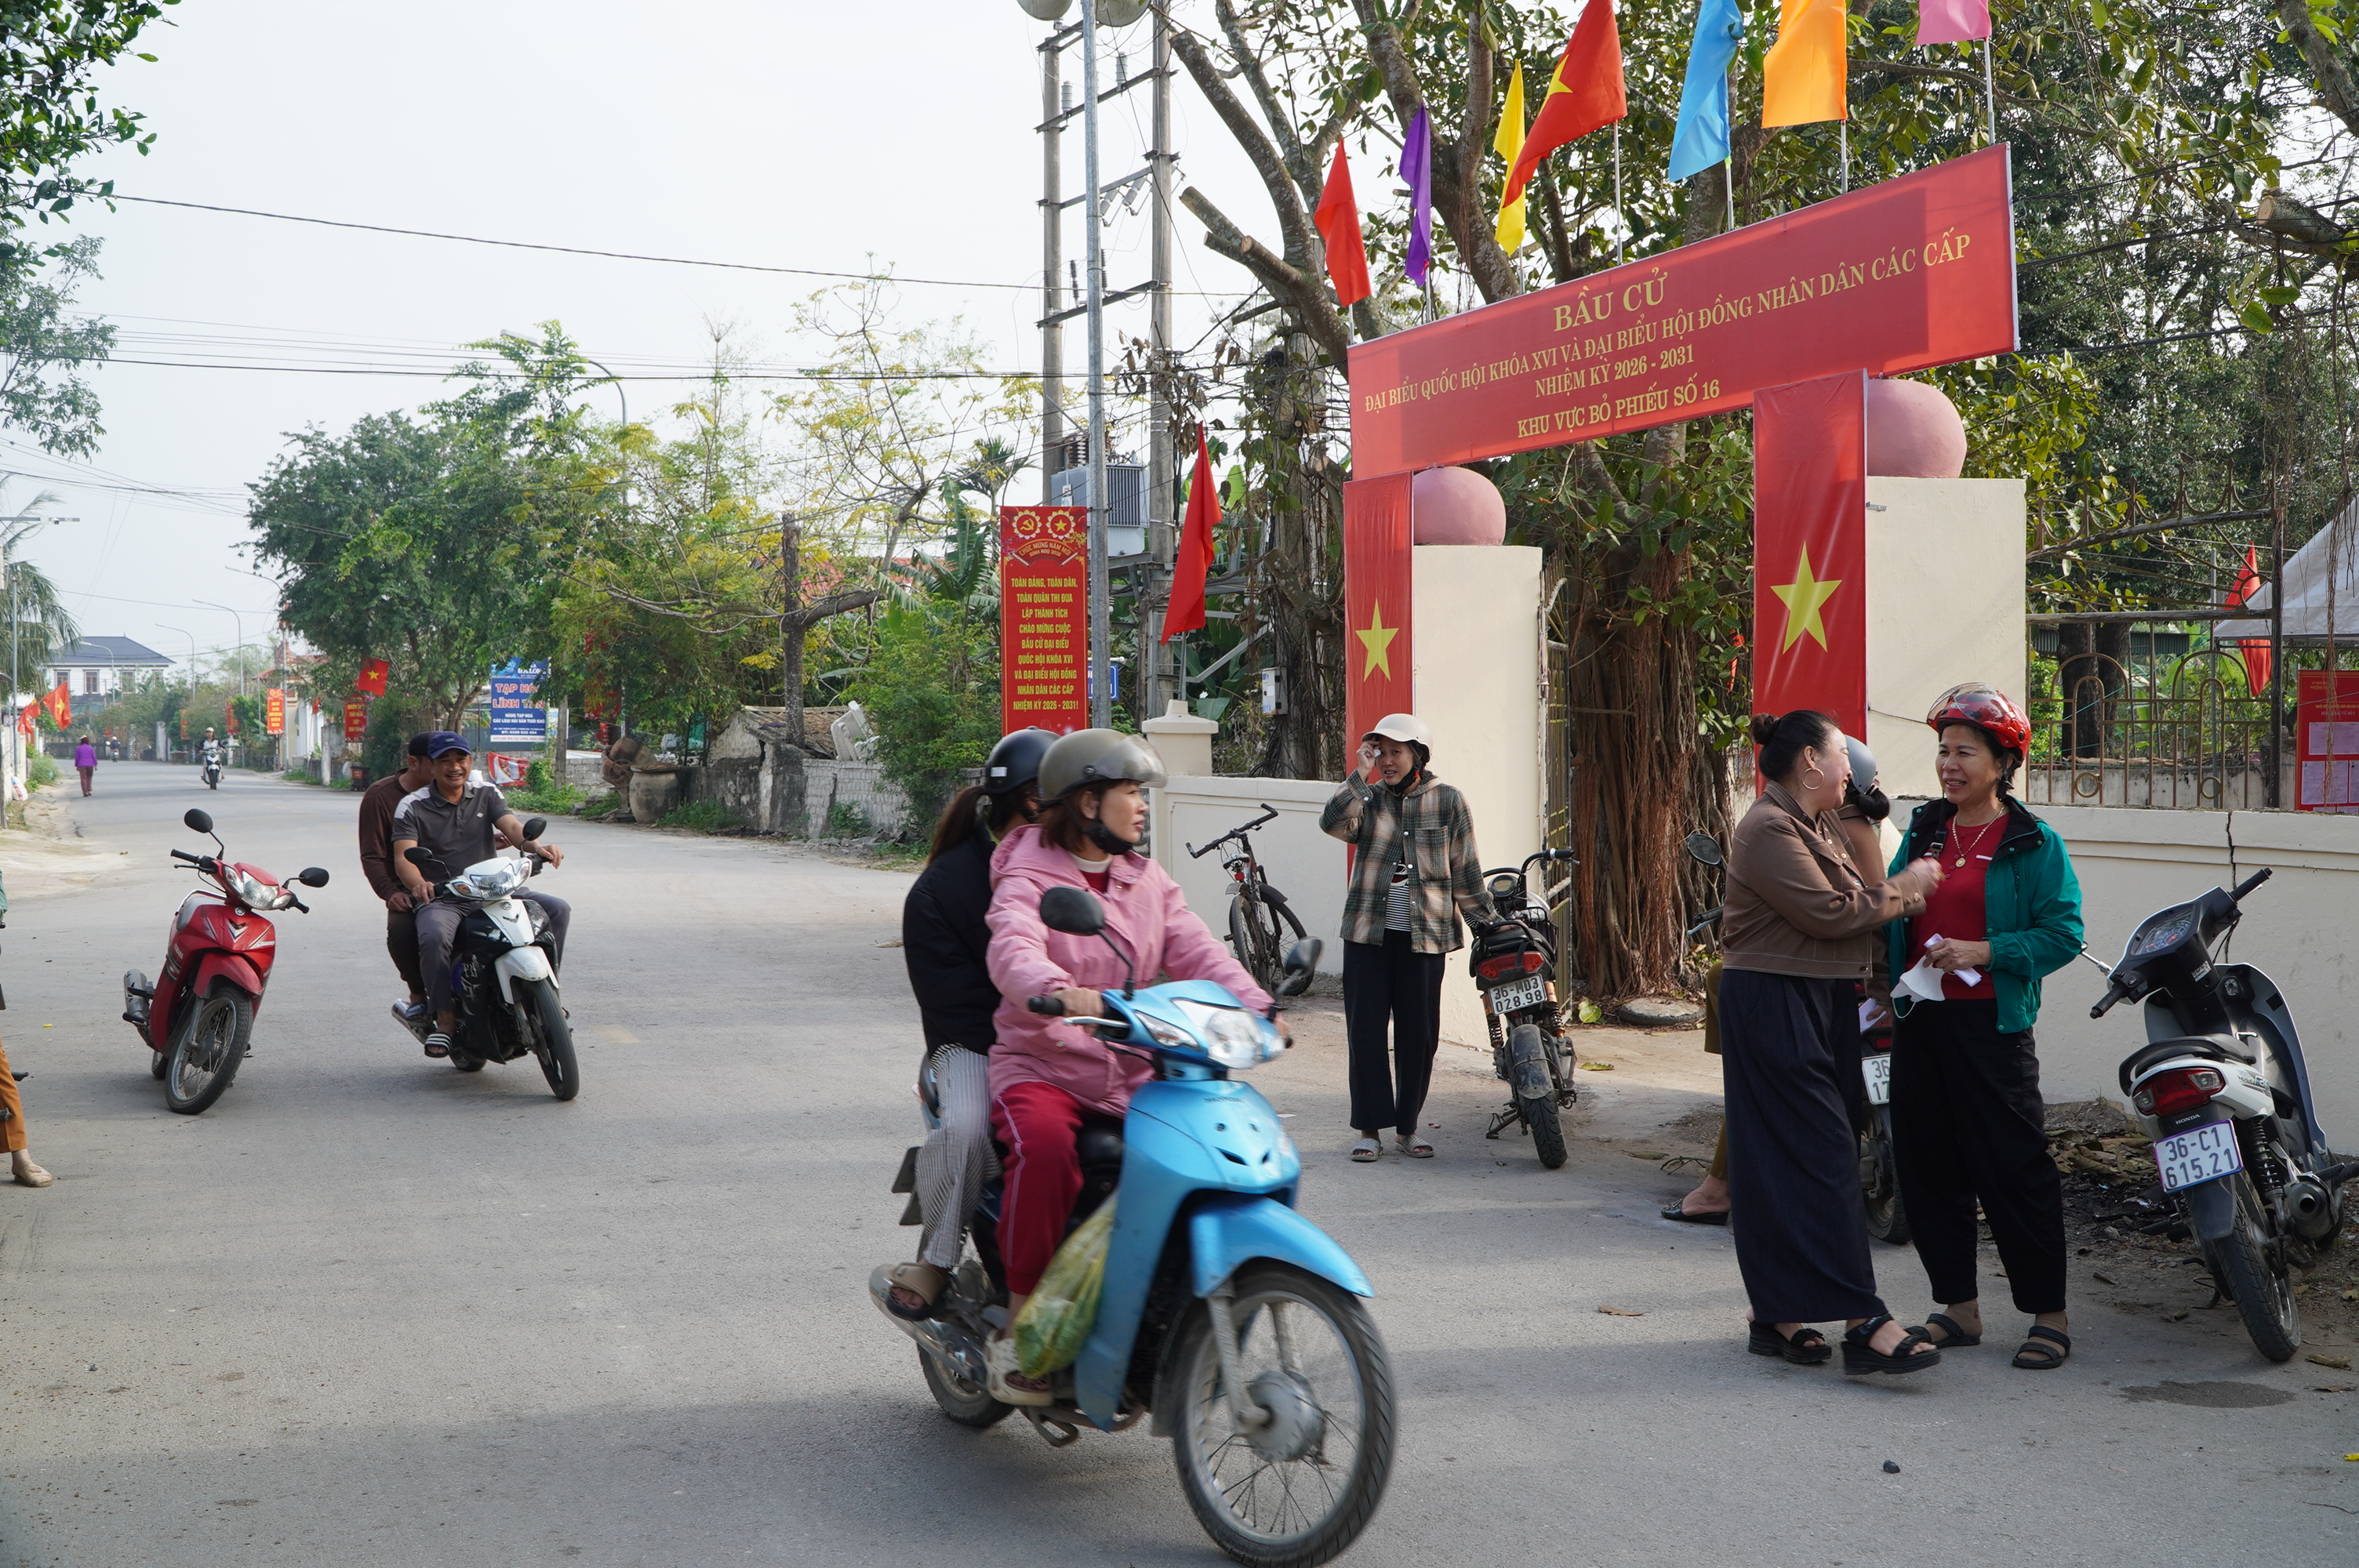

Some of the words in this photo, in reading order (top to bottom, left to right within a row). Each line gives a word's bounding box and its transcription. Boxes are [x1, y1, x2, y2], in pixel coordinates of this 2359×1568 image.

[1554, 285, 1614, 332] BẦU
[1623, 267, 1668, 311] CỬ
[1365, 392, 1387, 414] ĐẠI
[1388, 376, 1418, 407] BIỂU
[1421, 368, 1458, 401] QUỐC
[1461, 363, 1485, 390] HỘI
[1489, 352, 1530, 382] KHÓA
[1532, 347, 1558, 371] XVI
[1561, 336, 1582, 363] VÀ
[1584, 334, 1612, 361] ĐẠI
[1617, 314, 1657, 350] BIỂU
[1662, 309, 1694, 340] HỘI
[1699, 294, 1753, 329] ĐỒNG
[1757, 277, 1815, 314] NHÂN
[1819, 261, 1865, 296] DÂN
[1871, 246, 1916, 281] CÁC
[1923, 227, 1971, 267] CẤP
[1535, 368, 1586, 398] NHIỆM
[1590, 358, 1611, 387] KỲ
[1614, 355, 1648, 380] 2026
[1660, 344, 1694, 370] 2031
[1518, 415, 1550, 438] KHU
[1554, 406, 1585, 434] VỰC
[1589, 394, 1611, 424] BỎ
[1616, 381, 1669, 419] PHIẾU
[1674, 372, 1698, 407] SỐ
[1702, 379, 1720, 401] 16
[1011, 575, 1027, 587] TOÀN
[1027, 575, 1046, 588] ĐẢNG,
[1047, 575, 1063, 587] TOÀN
[1063, 575, 1078, 588] DÂN,
[1016, 591, 1032, 602] TOÀN
[1034, 591, 1049, 604] QUÂN
[1051, 593, 1060, 602] THI
[1061, 593, 1073, 602] ĐUA
[1022, 607, 1033, 620] LẬP
[1034, 607, 1054, 618] THÀNH
[1055, 607, 1068, 618] TÍCH
[1019, 622, 1034, 633] CHÀO
[1036, 622, 1054, 633] MỪNG
[1055, 622, 1071, 635] CUỘC
[1022, 636, 1034, 648] BẦU
[1035, 636, 1044, 648] CỬ
[1044, 639, 1054, 651] ĐẠI
[1056, 635, 1069, 648] BIỂU
[1018, 652, 1034, 665] QUỐC
[1035, 652, 1045, 666] HỘI
[1046, 652, 1062, 664] KHÓA
[1063, 655, 1073, 664] XVI
[1014, 668, 1023, 680] VÀ
[1023, 670, 1034, 681] ĐẠI
[1035, 666, 1049, 680] BIỂU
[1049, 668, 1060, 681] HỘI
[1060, 667, 1077, 679] ĐỒNG
[495, 683, 518, 695] TẠP
[1017, 684, 1034, 695] NHÂN
[1035, 684, 1048, 694] DÂN
[1049, 683, 1061, 694] CÁC
[1062, 682, 1074, 694] CẤP
[493, 696, 519, 708] LĨNH
[1013, 699, 1032, 713] NHIỆM
[1034, 699, 1041, 710] KỲ
[1042, 700, 1057, 710] 2026
[1062, 700, 1078, 710] 2031!
[1496, 990, 1543, 1012] 028.98
[2175, 1114, 2201, 1124] HONDA
[2165, 1127, 2220, 1161] 36-C1
[2165, 1148, 2234, 1188] 615.21
